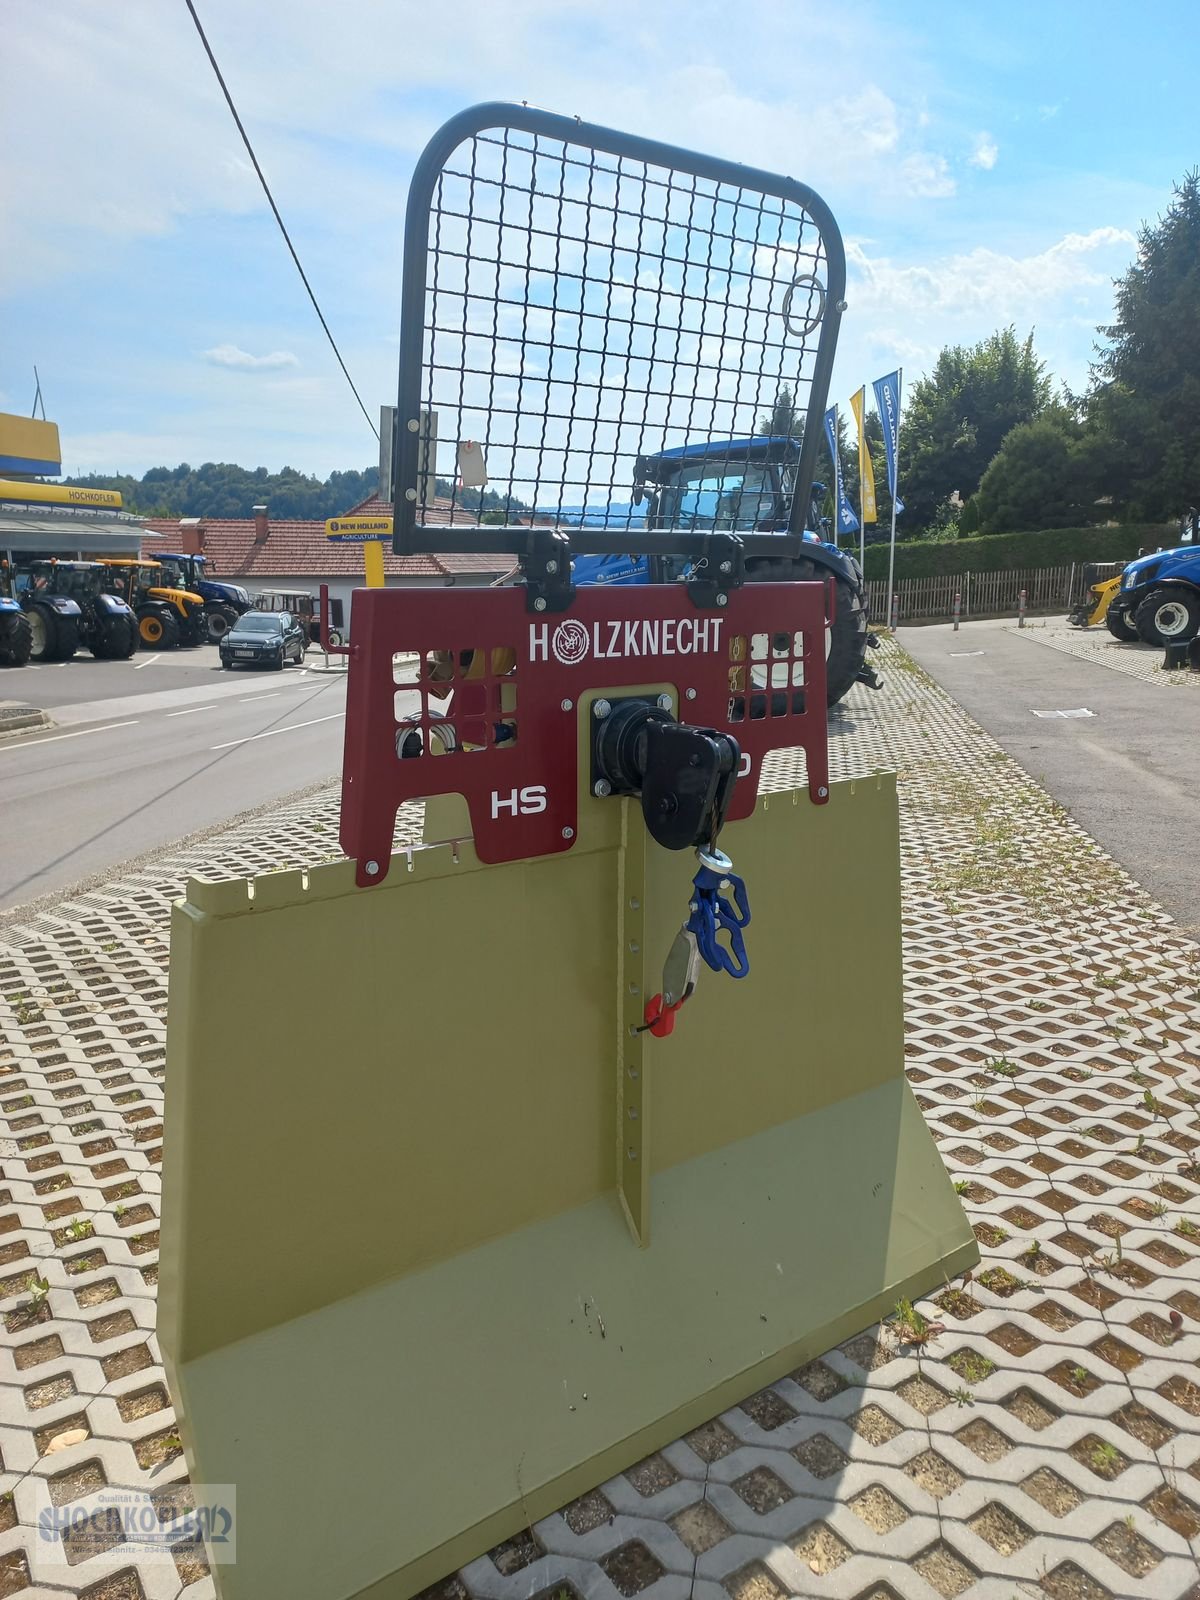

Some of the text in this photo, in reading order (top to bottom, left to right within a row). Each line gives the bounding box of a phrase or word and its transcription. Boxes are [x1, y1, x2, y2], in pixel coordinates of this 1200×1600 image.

[68, 491, 115, 502] HOCHKOFLER
[357, 522, 389, 530] HOLLAND
[606, 566, 646, 580] NEW HOLLAND
[529, 618, 724, 664] HOLZKNECHT
[491, 785, 547, 819] HS
